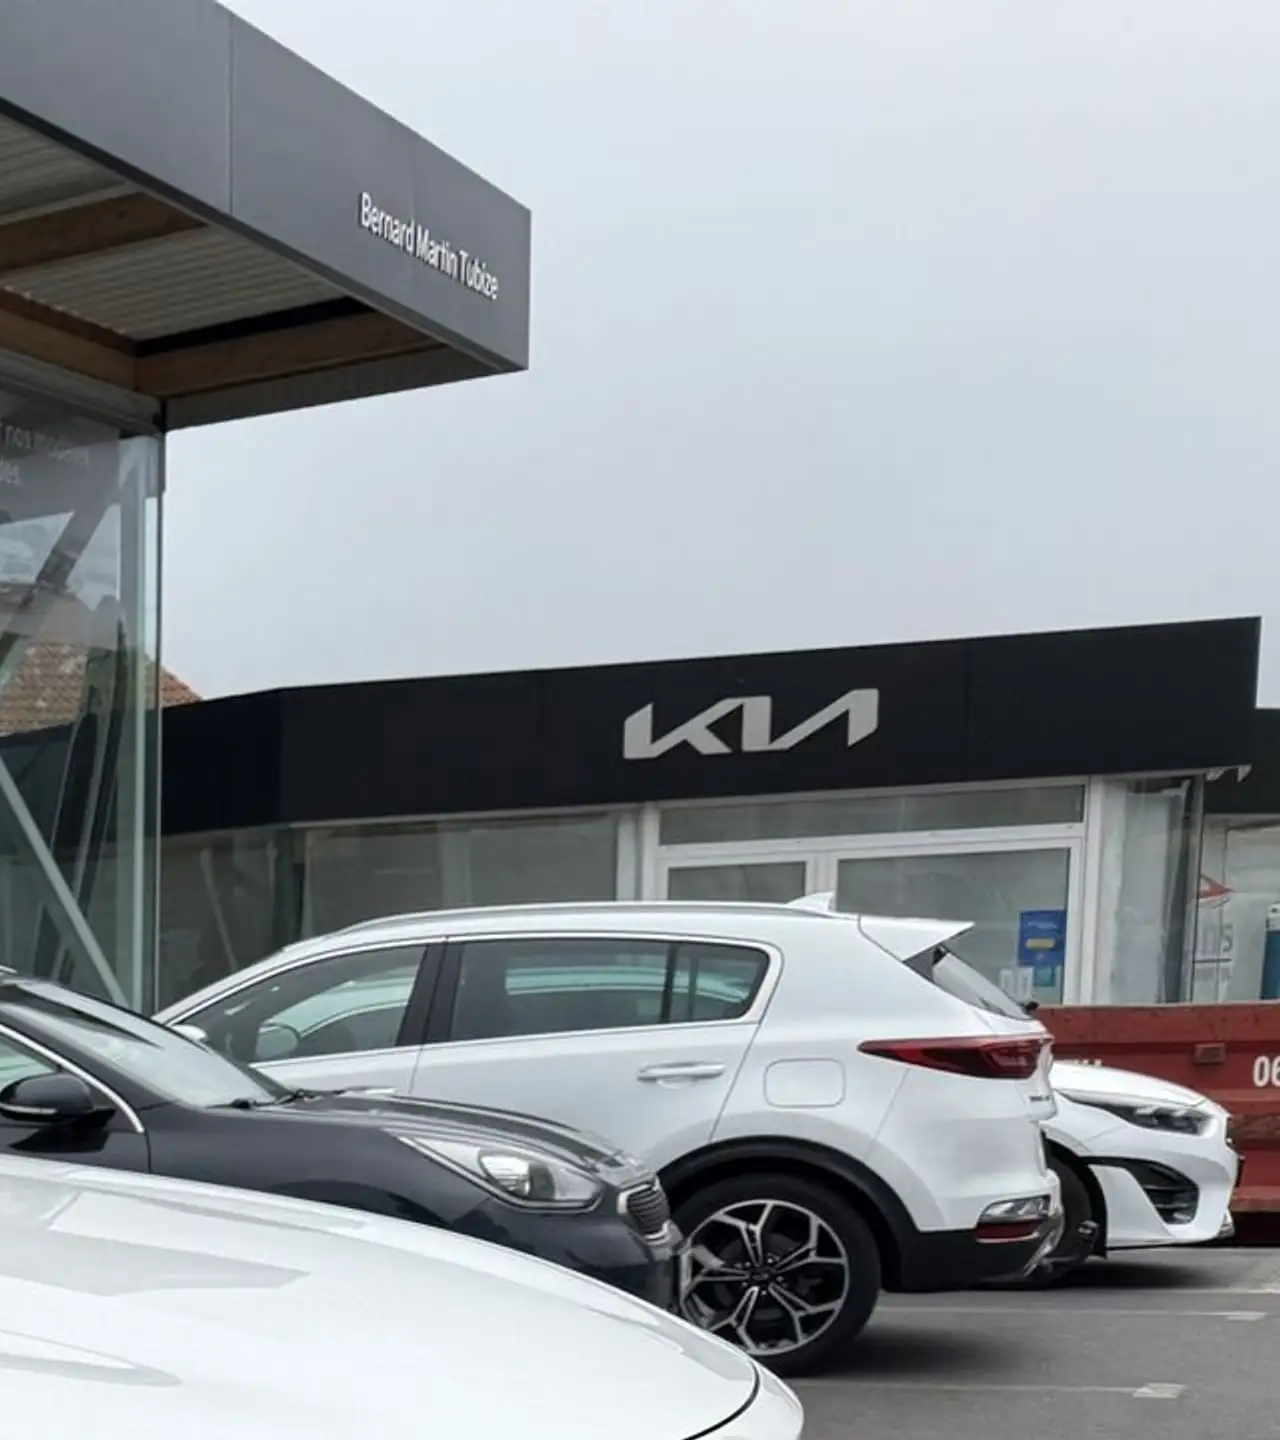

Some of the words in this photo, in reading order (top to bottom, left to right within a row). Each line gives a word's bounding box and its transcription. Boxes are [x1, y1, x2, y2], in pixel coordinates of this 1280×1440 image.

[360, 191, 416, 253] Bernard
[416, 224, 458, 280] Martin
[457, 250, 499, 300] Tubize
[623, 687, 879, 760] KIA
